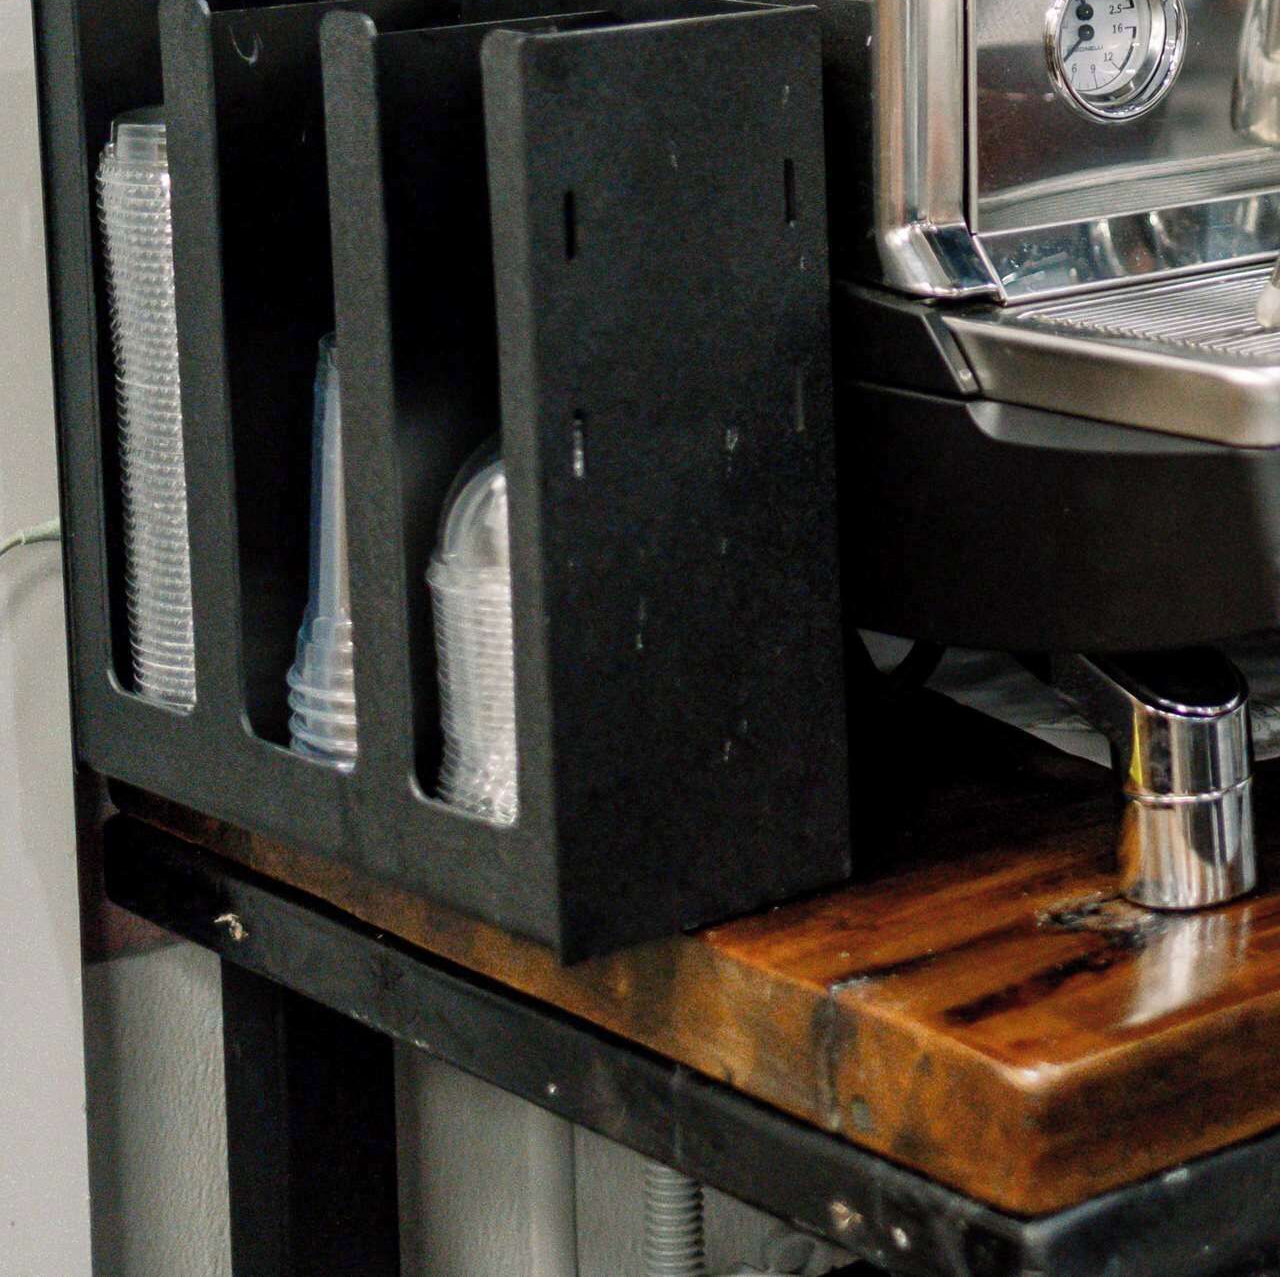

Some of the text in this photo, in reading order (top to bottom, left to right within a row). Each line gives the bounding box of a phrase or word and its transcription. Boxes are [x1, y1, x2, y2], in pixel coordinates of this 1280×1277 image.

[1109, 4, 1122, 15] 2.5
[1112, 24, 1124, 34] 16
[1103, 52, 1113, 62] 12
